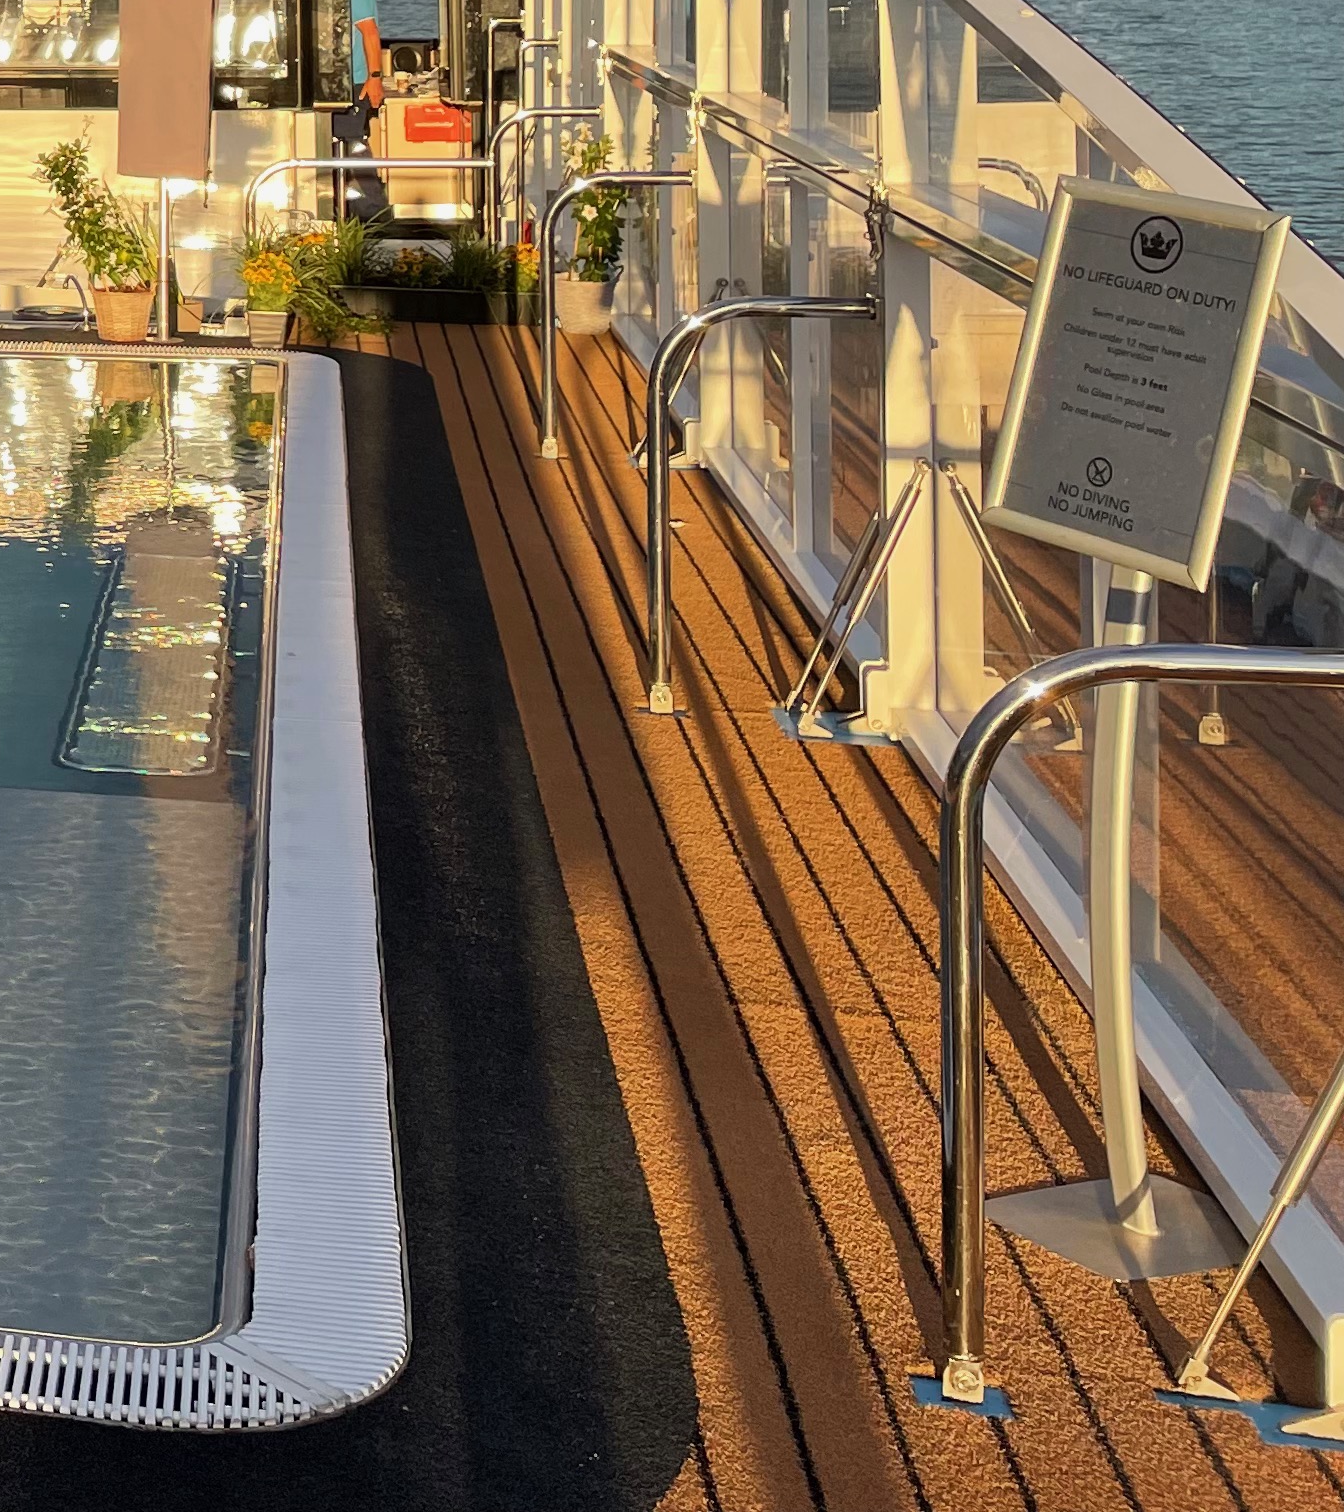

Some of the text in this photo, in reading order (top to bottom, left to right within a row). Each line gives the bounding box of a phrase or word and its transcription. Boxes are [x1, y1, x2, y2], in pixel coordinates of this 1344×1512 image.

[1063, 264, 1237, 313] NO LIFEGUARD ON DUTY!
[1092, 307, 1114, 321] Swim
[1115, 314, 1125, 323] at
[1126, 317, 1146, 327] your
[1064, 322, 1098, 338] Children
[1099, 332, 1123, 344] under
[1126, 336, 1137, 348] 12
[1138, 342, 1160, 354] must
[1161, 345, 1182, 359] have
[1084, 362, 1103, 375] Pool
[1140, 377, 1147, 386] 3
[1149, 378, 1168, 391] feet
[1076, 383, 1165, 414] No Glass in pool area
[1061, 401, 1074, 412] Do
[1075, 407, 1089, 417] not
[1124, 420, 1145, 431] pool
[1146, 426, 1172, 438] water
[1048, 495, 1134, 532] NO JUMPING
[1058, 481, 1130, 513] NO DIVING
